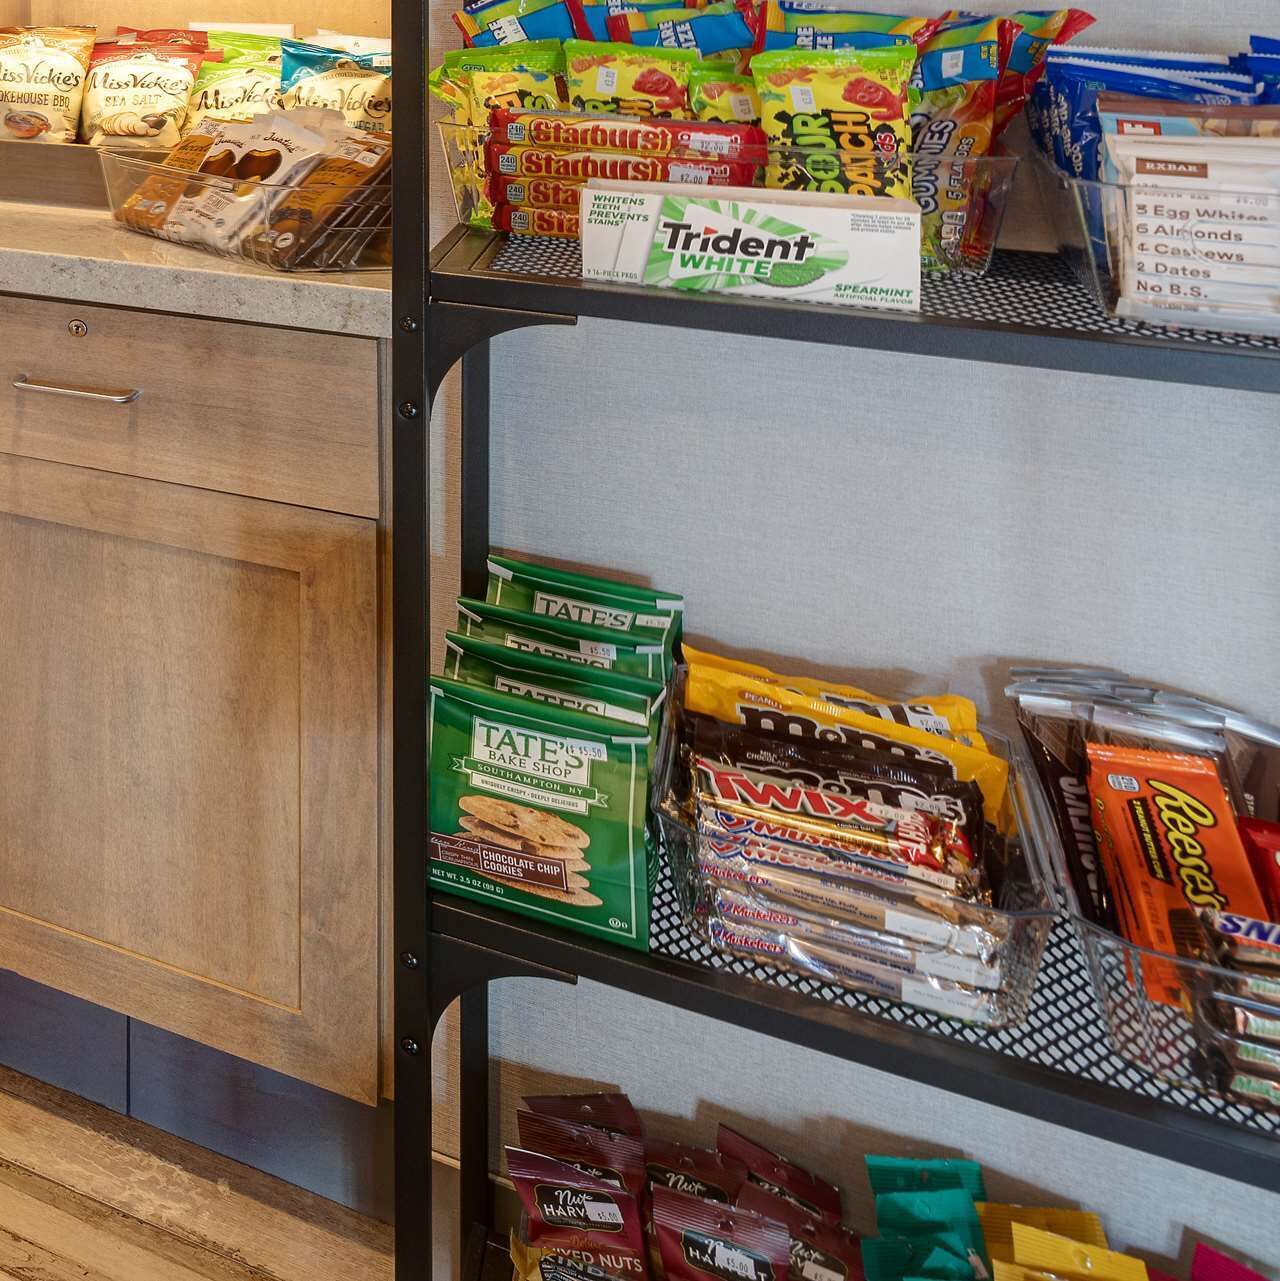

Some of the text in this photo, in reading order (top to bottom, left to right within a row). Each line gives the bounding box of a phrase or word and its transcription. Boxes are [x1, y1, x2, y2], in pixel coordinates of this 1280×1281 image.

[19, 60, 81, 93] Vickie's
[88, 72, 189, 96] Miss Vickie's
[52, 95, 70, 108] BBQ
[104, 94, 162, 108] SEA SALT
[531, 119, 671, 152] Starburst
[500, 155, 516, 165] 240
[523, 150, 661, 181] Starburst
[1145, 162, 1199, 172] RXBAR
[680, 175, 704, 185] $2.00
[591, 202, 621, 211] TEETH
[592, 194, 646, 207] WHITENS
[589, 210, 649, 221] PREVENTS
[1153, 204, 1190, 220] Egg
[662, 221, 815, 261] Trident
[678, 253, 774, 277] WHITE
[1155, 263, 1212, 279] Dates
[834, 283, 914, 298] SPEARMINT
[1136, 280, 1209, 298] No B.S.
[834, 292, 914, 306] ARTIFICIAL FLAVOR
[538, 594, 632, 631] TATE'S
[744, 692, 784, 710] PEANUT
[478, 722, 584, 769] TATE'S
[488, 750, 572, 779] BAKE SHOP
[477, 763, 583, 795] SOUTHAMPTON, NY
[481, 779, 579, 808] UNIQUELY CRISPY DEEPLY DELICIOUS
[697, 759, 888, 825] TWIX
[1147, 779, 1228, 911] Reese's
[482, 850, 536, 871] CHOCOLATE
[537, 862, 561, 875] CHIP
[483, 861, 524, 877] COOKIES
[432, 868, 459, 880] NET WT.
[666, 1172, 706, 1193] Nut
[555, 1190, 593, 1206] Nut
[600, 1254, 643, 1272] NUTS
